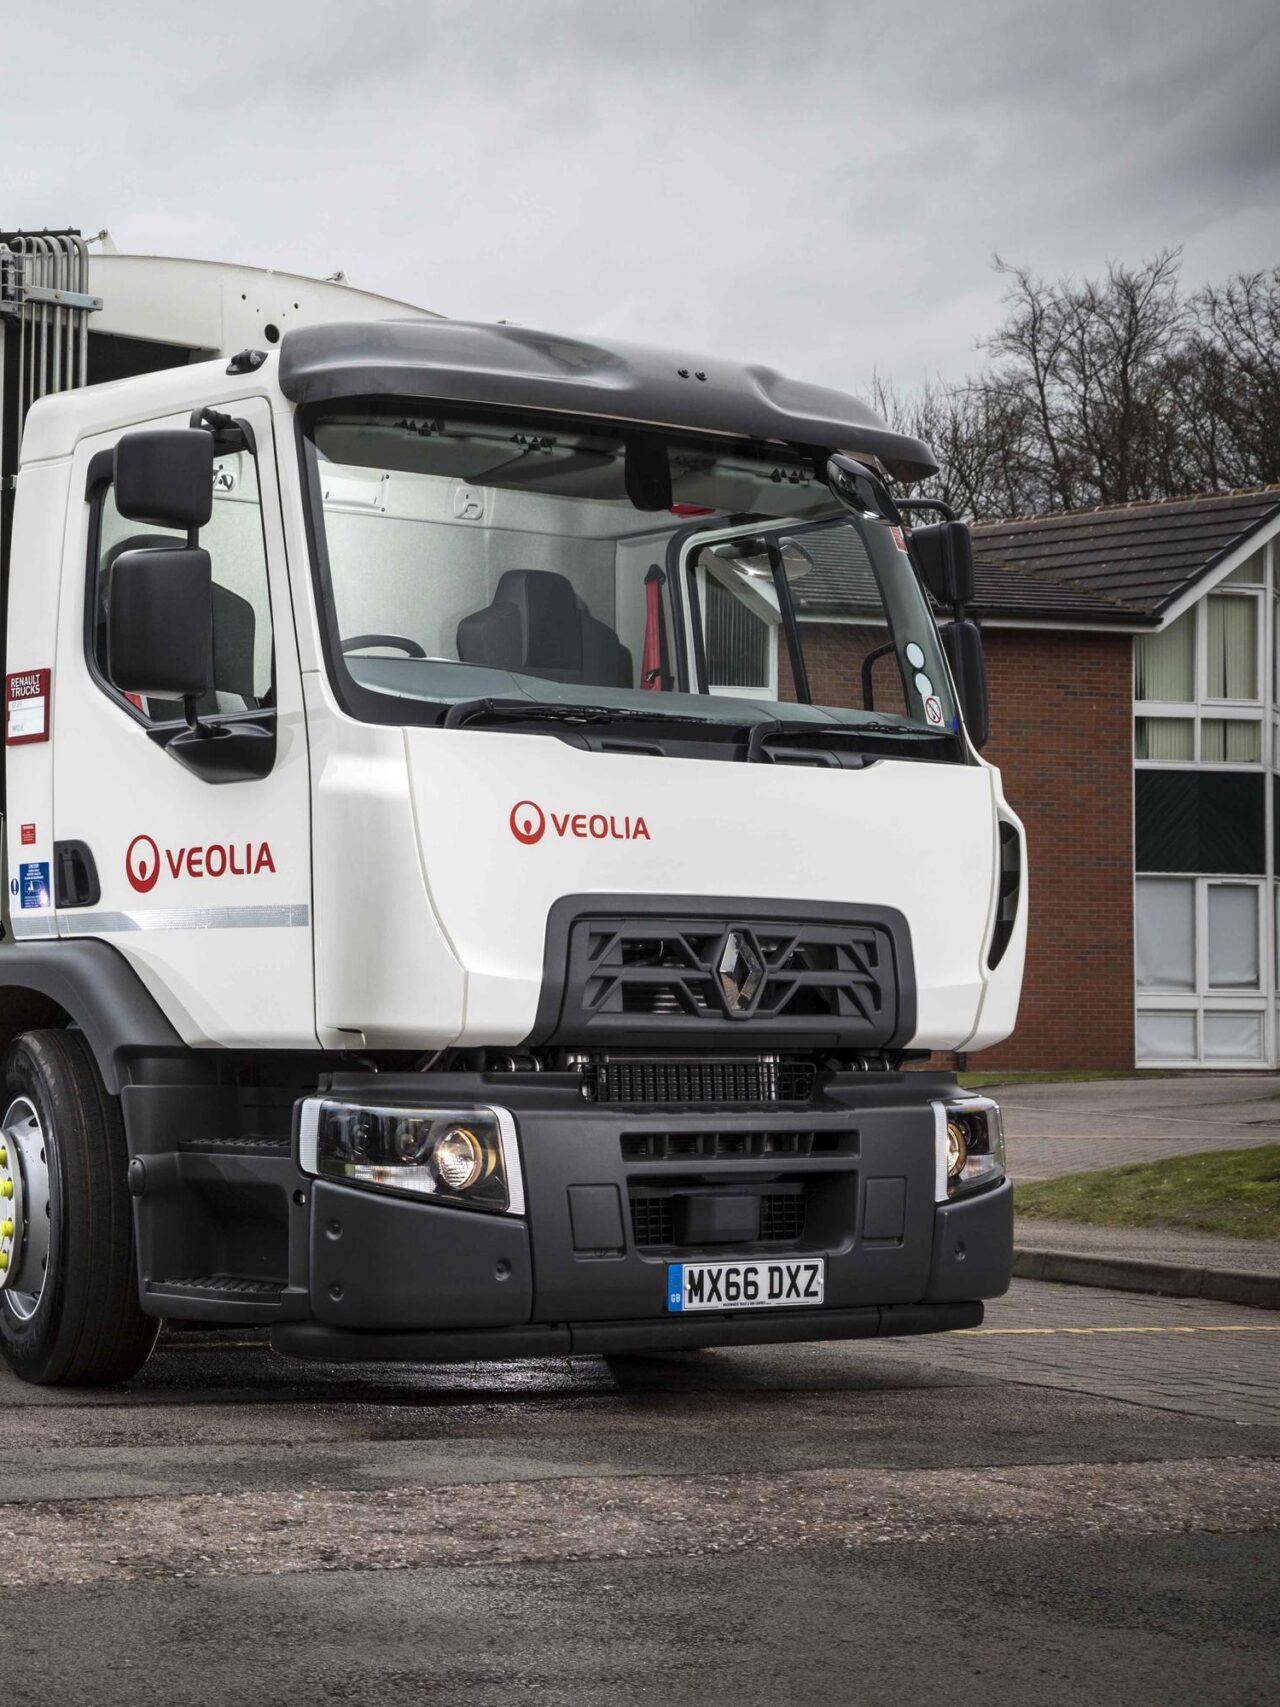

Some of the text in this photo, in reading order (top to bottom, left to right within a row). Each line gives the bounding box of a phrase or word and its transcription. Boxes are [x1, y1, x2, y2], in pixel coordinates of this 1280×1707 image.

[10, 674, 41, 688] RENAULT
[11, 684, 41, 698] TRUCKS
[550, 813, 651, 840] VEOLIA
[165, 841, 276, 879] VEOLIA
[688, 1264, 819, 1303] MX66 DXZ
[670, 1293, 681, 1303] GB
